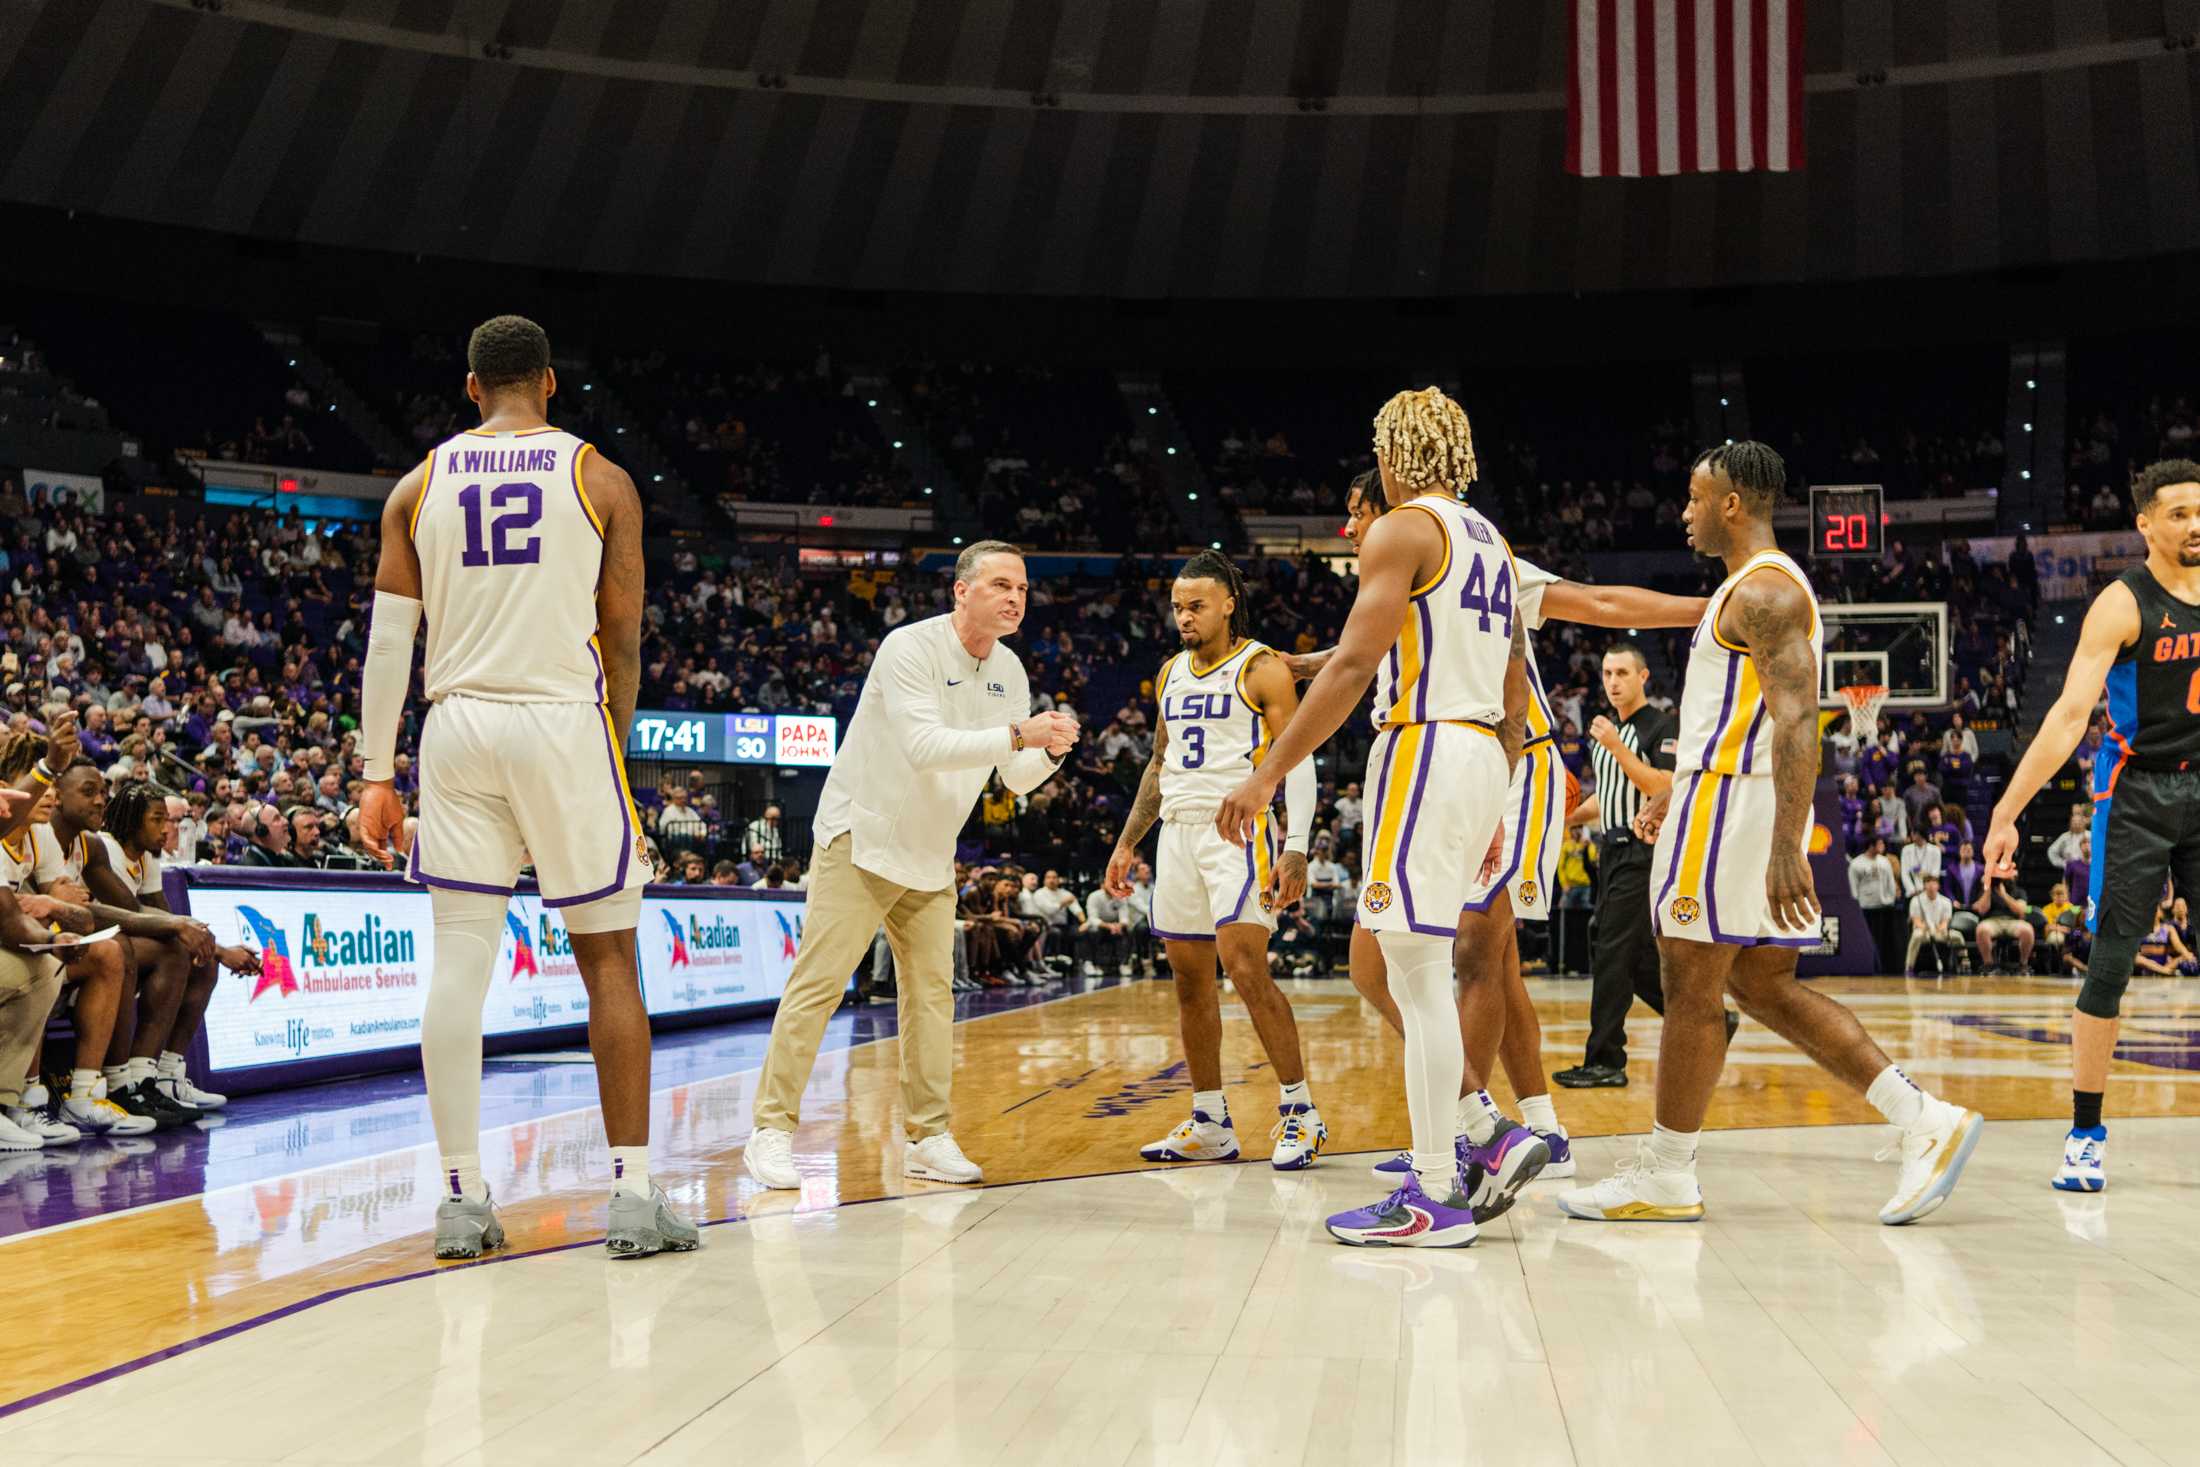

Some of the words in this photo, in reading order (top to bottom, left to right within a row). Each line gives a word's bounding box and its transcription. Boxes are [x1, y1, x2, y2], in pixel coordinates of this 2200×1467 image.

[448, 448, 557, 475] K.WILLIAMS
[458, 482, 543, 568] 12
[1825, 514, 1867, 550] 20
[1460, 552, 1512, 640] 44
[2153, 631, 2200, 663] GAT
[987, 682, 1004, 693] LSU
[1165, 693, 1232, 722] LSU
[636, 718, 706, 752] 17:41
[734, 717, 769, 733] LSU
[782, 724, 828, 742] PAPA
[736, 736, 766, 759] 30
[780, 746, 829, 759] JOHNS
[1182, 726, 1205, 769] 3
[301, 912, 416, 968] Acadian
[689, 913, 741, 950] Acadian
[303, 969, 372, 993] Ambulance
[375, 967, 417, 989] Service
[286, 1018, 310, 1056] life
